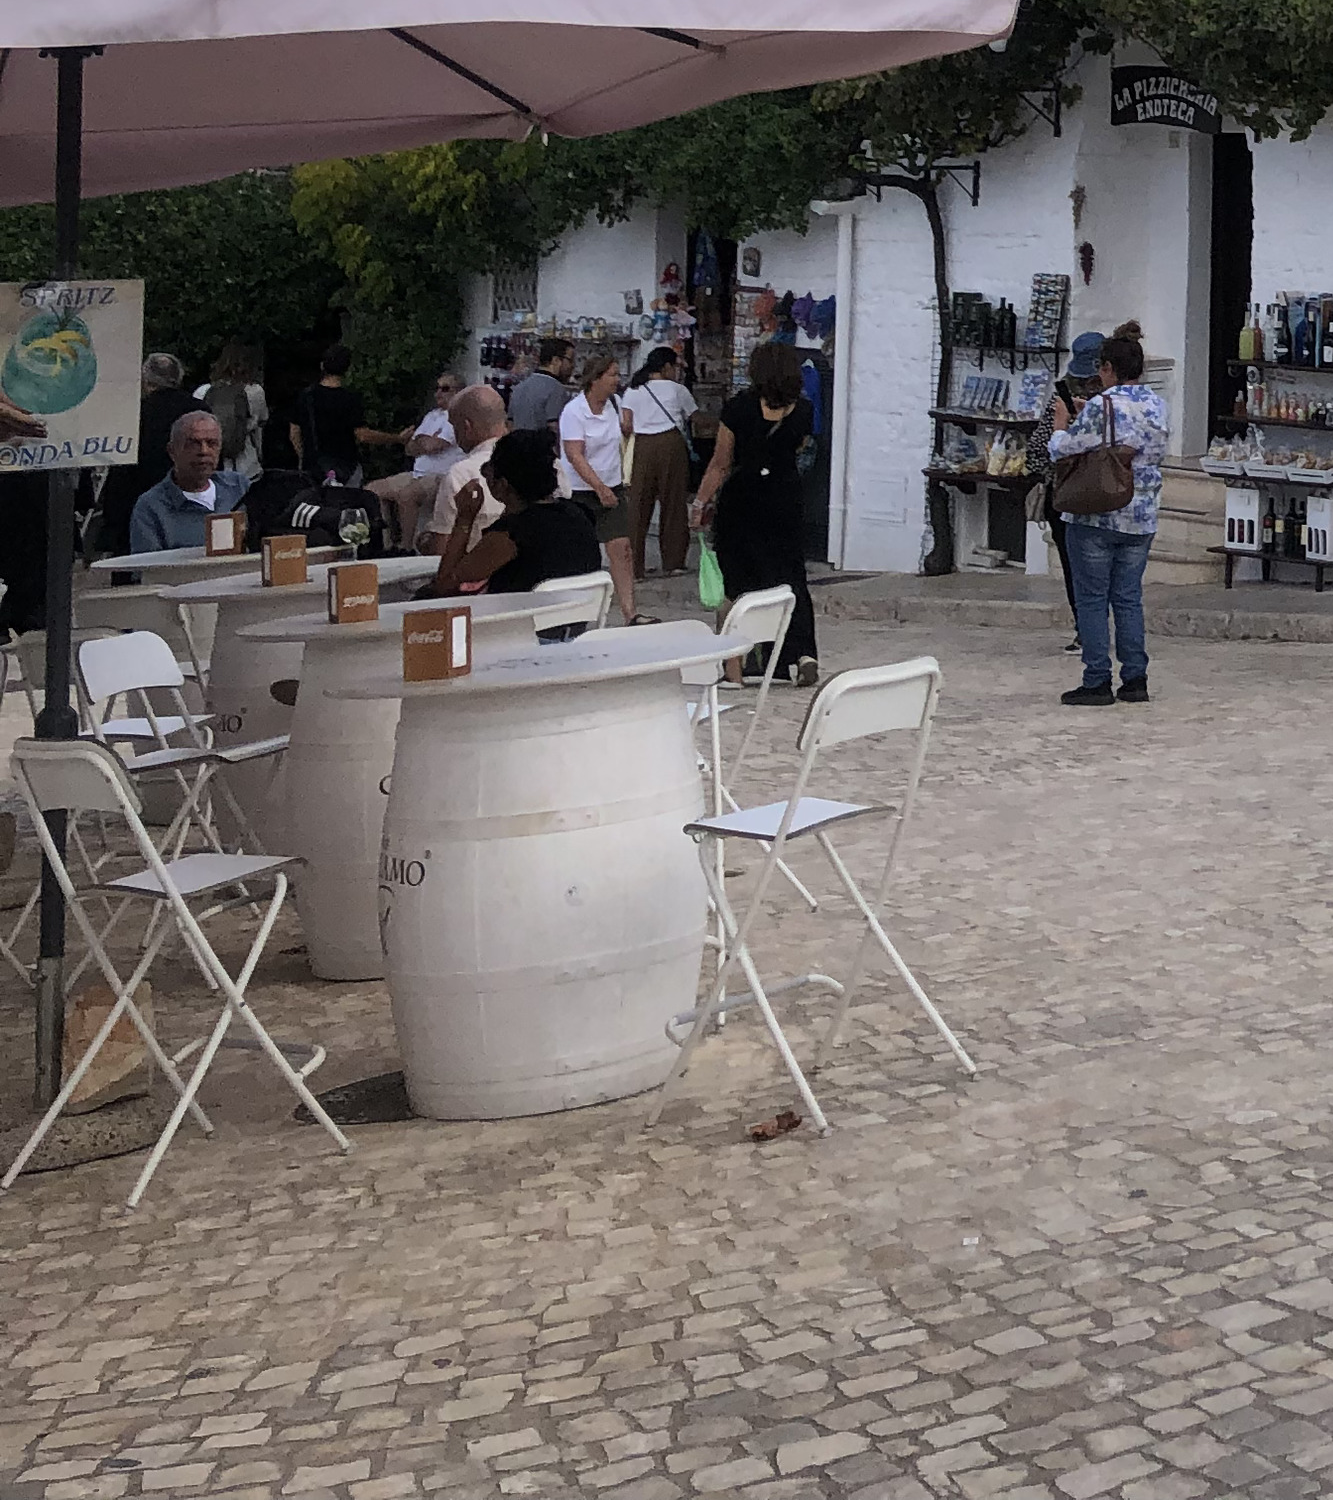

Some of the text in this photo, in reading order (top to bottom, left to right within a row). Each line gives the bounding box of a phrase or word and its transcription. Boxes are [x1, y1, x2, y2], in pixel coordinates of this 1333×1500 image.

[1114, 87, 1133, 111] LA
[1135, 98, 1195, 125] ENOTECA
[20, 286, 116, 308] SPRITZ
[0, 436, 133, 466] ONDA BLU
